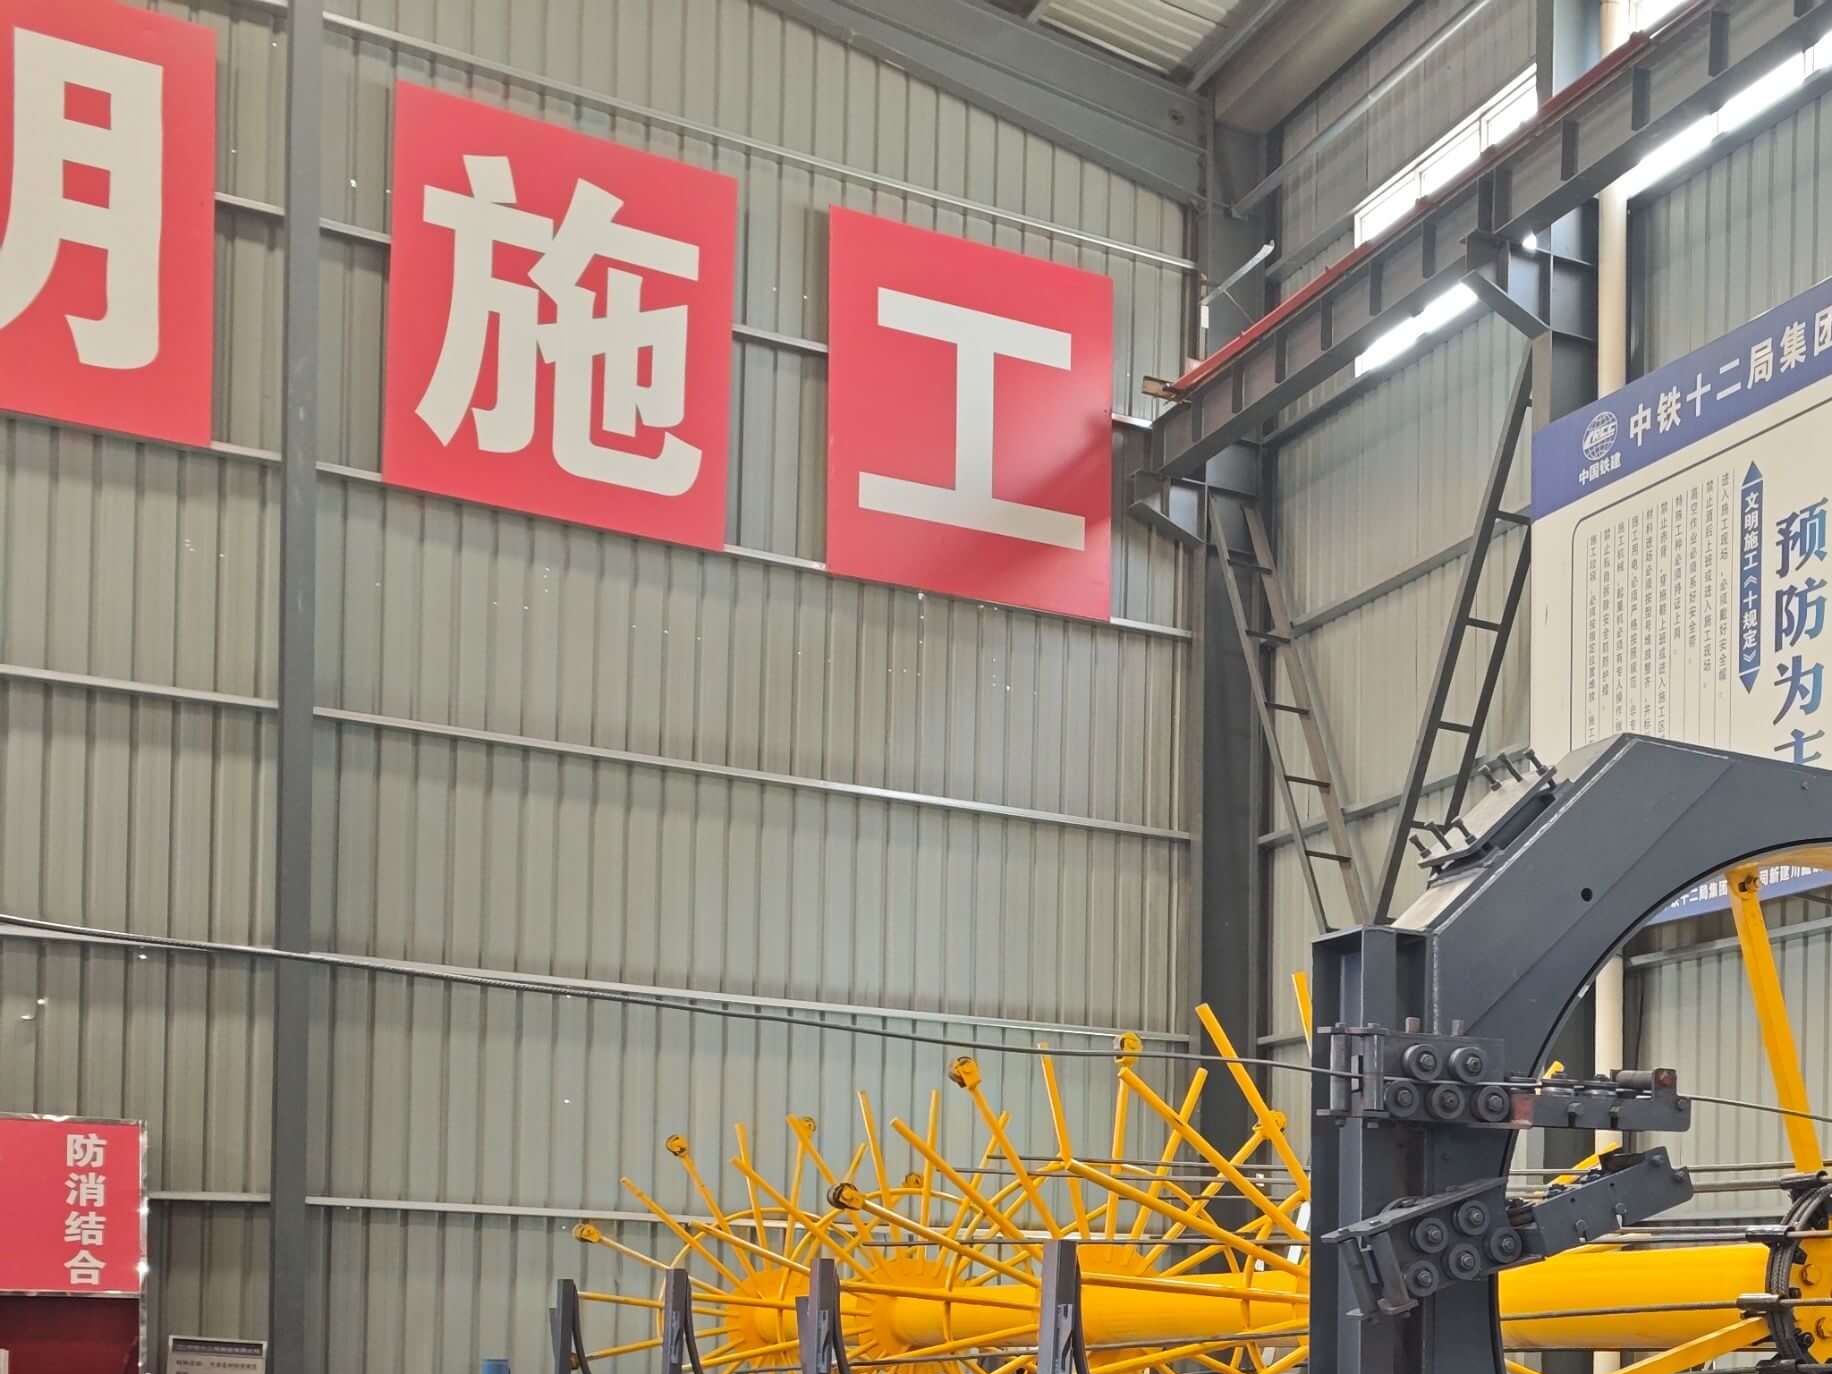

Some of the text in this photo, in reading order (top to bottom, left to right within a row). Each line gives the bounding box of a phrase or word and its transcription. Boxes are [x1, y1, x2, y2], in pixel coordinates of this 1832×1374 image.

[1743, 491, 1760, 663] 文明施工《十规定》
[1772, 496, 1830, 764] 预防为主
[63, 1133, 108, 1285] 防消结合
